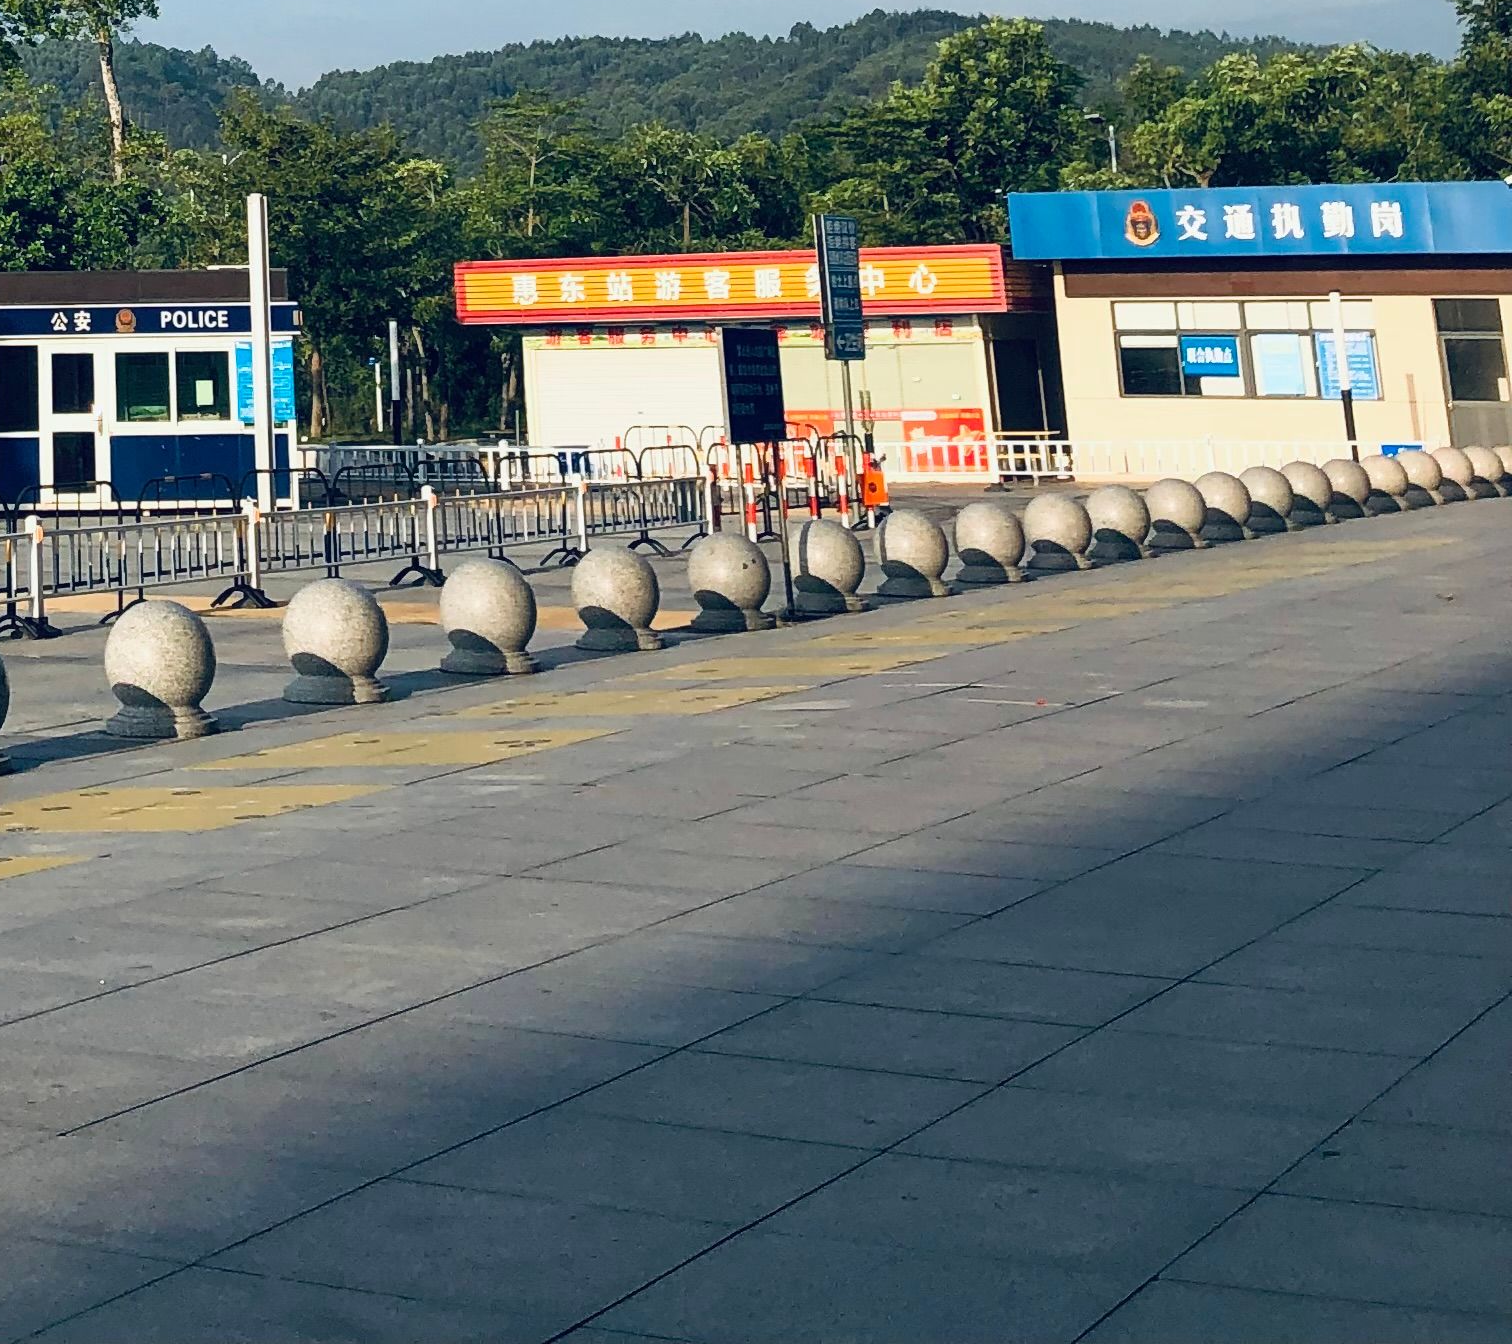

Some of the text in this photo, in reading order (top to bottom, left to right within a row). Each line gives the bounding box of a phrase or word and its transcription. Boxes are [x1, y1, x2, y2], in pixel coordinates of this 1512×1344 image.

[1175, 200, 1404, 241] 交通执勤岗
[50, 311, 92, 332] 公安
[160, 310, 229, 329] POLICE
